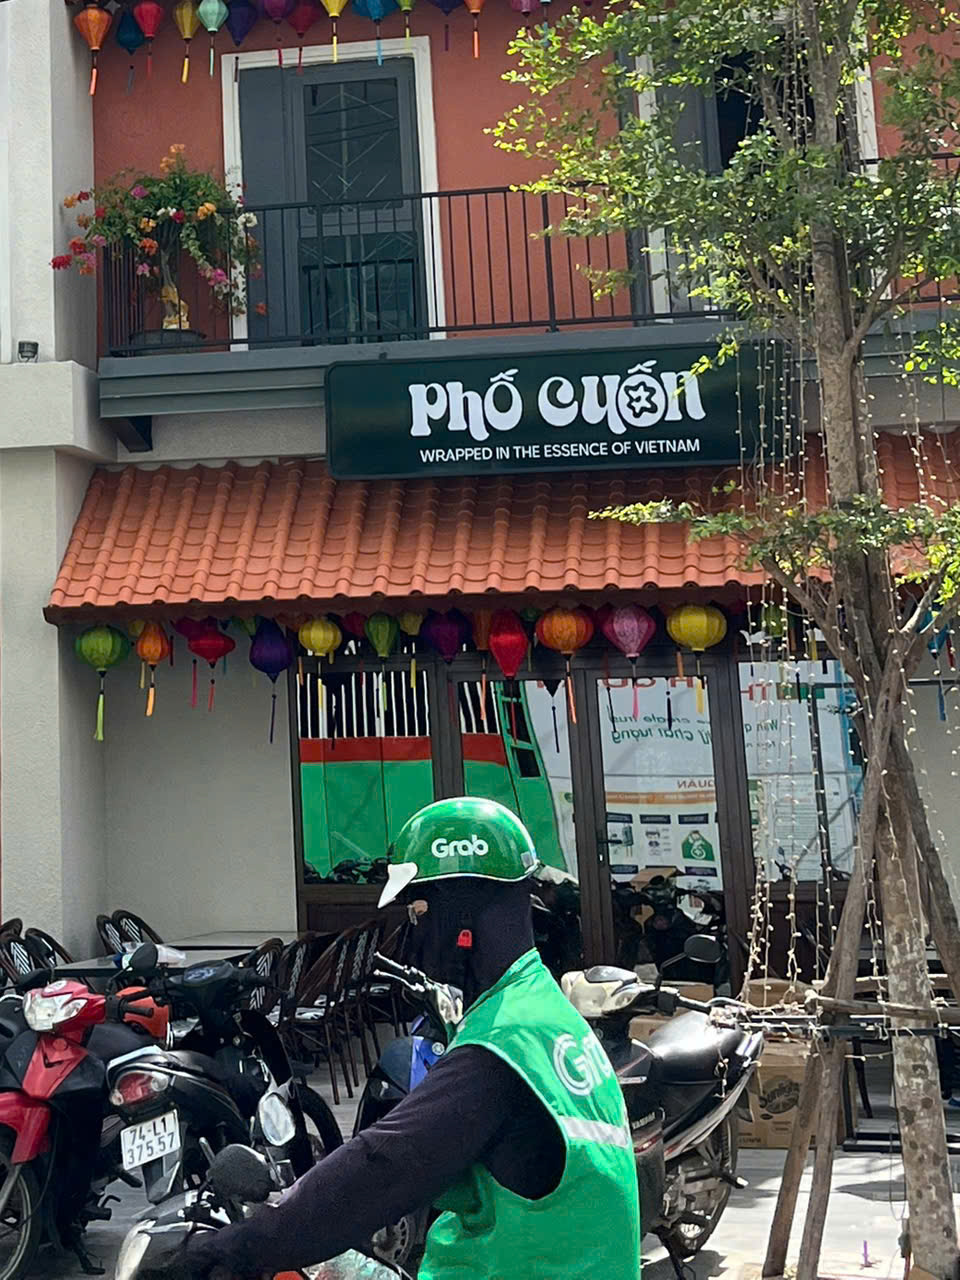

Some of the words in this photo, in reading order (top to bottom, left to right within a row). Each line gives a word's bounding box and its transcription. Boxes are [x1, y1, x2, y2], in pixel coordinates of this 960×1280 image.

[419, 446, 494, 463] WRAPPED
[495, 445, 511, 460] IN
[513, 444, 540, 460] THE
[543, 442, 609, 458] ESSENCE
[611, 440, 633, 456] OF
[635, 438, 700, 455] VIETNAM
[431, 834, 489, 858] Grab
[129, 1117, 167, 1146] 74-L1
[127, 1131, 175, 1165] 375.57
